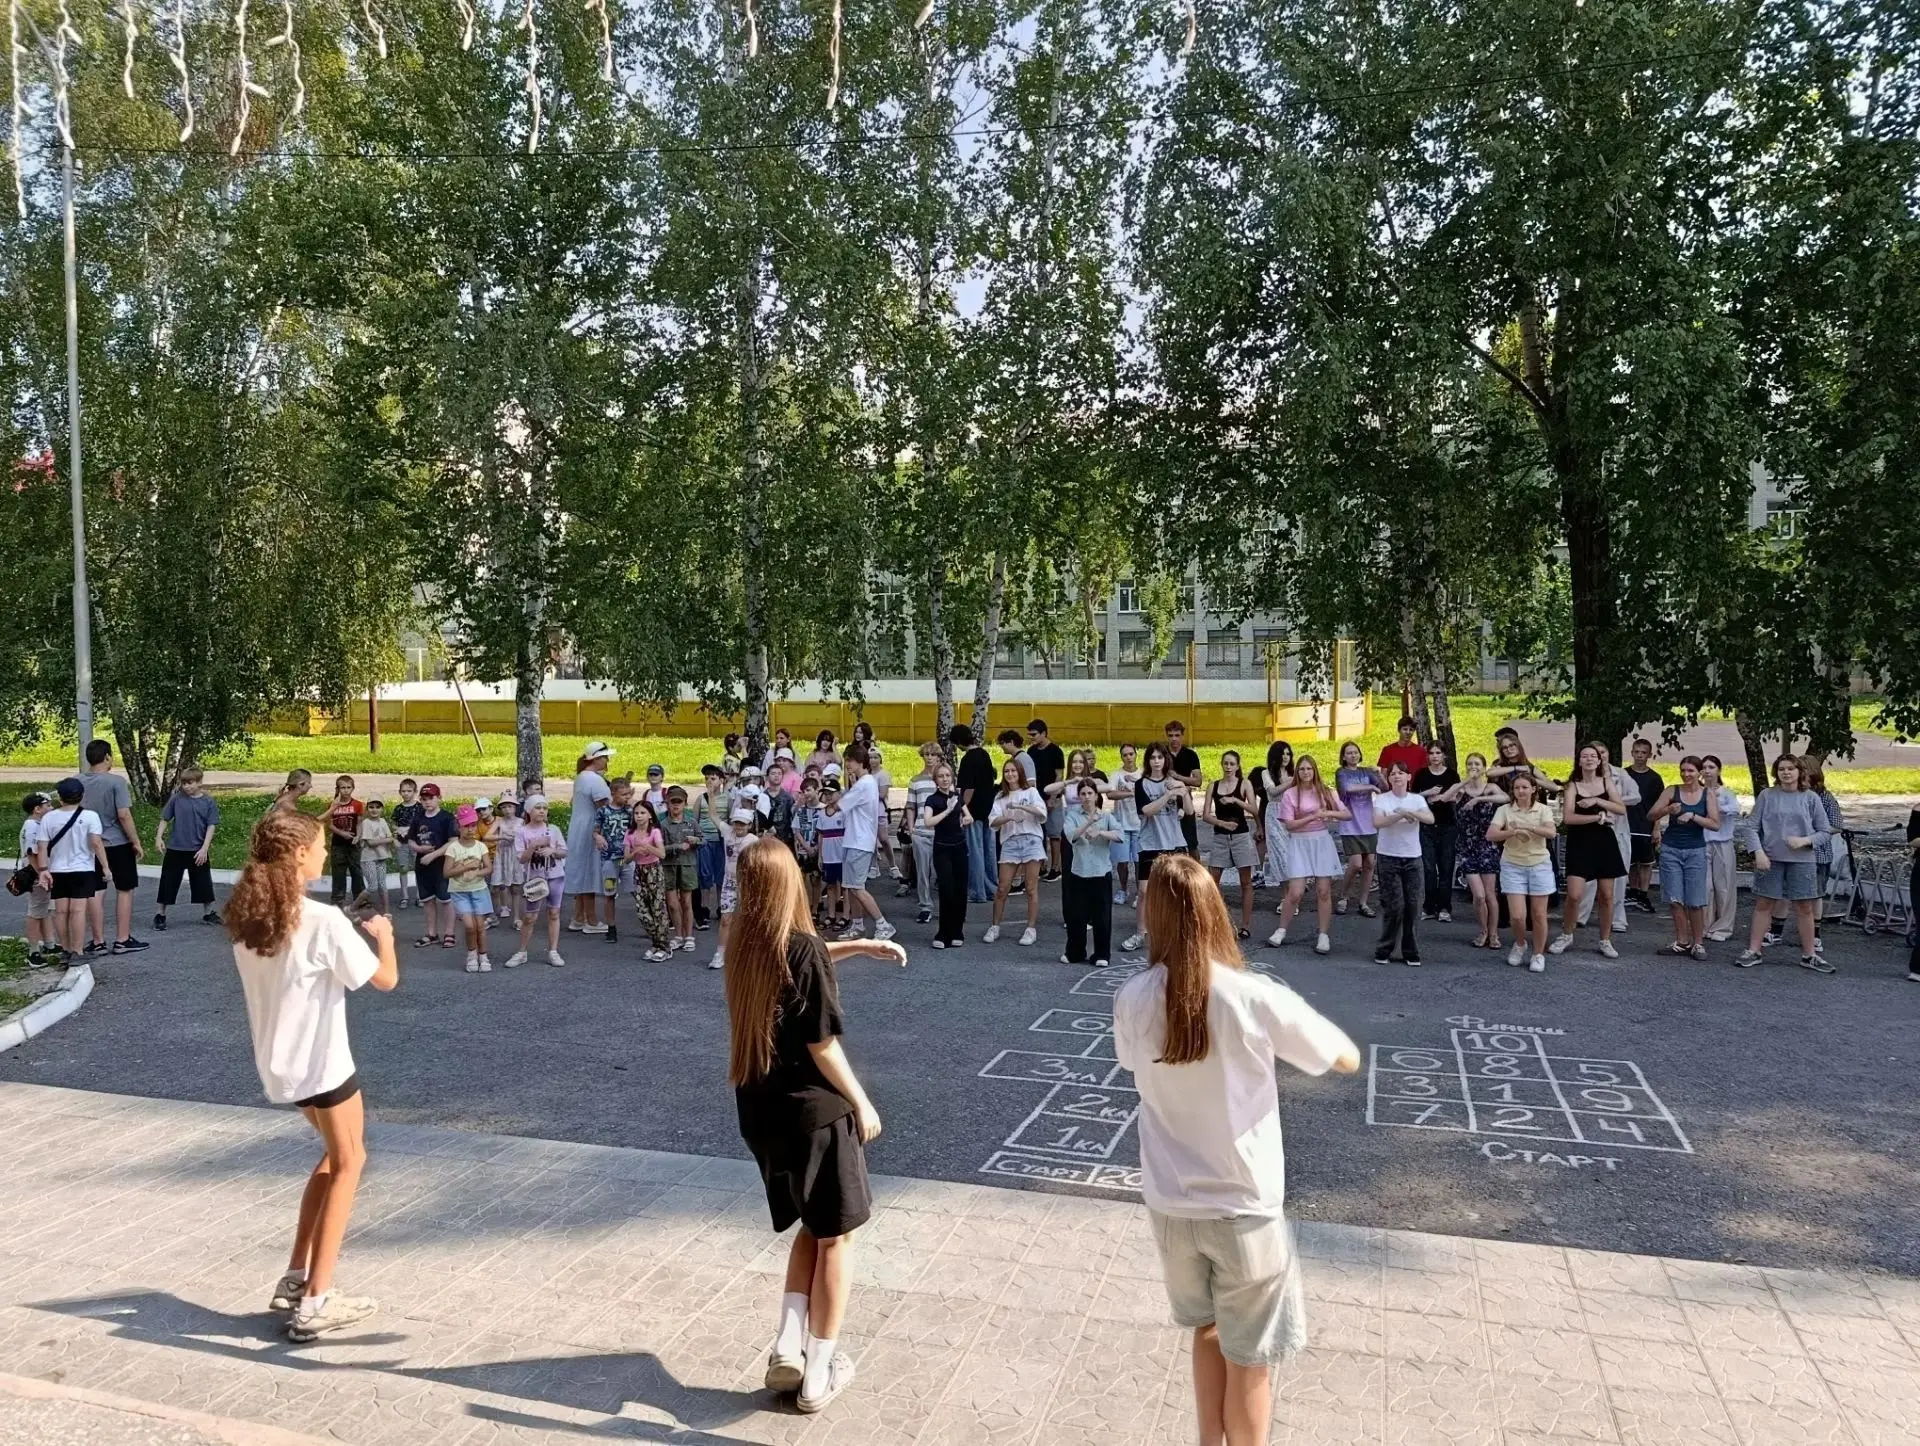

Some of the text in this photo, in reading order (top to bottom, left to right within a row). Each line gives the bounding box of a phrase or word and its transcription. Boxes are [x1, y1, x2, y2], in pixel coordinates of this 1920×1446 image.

[1465, 1033, 1528, 1052] 10
[1391, 1050, 1443, 1071] 6
[1481, 1055, 1521, 1078] 8
[1400, 1075, 1438, 1097] 3
[1577, 1063, 1621, 1087] 5
[1488, 1082, 1521, 1104] 1
[1580, 1088, 1634, 1113] 9
[1390, 1100, 1446, 1125] 7
[1491, 1108, 1544, 1131] 2
[1597, 1118, 1646, 1143] 4
